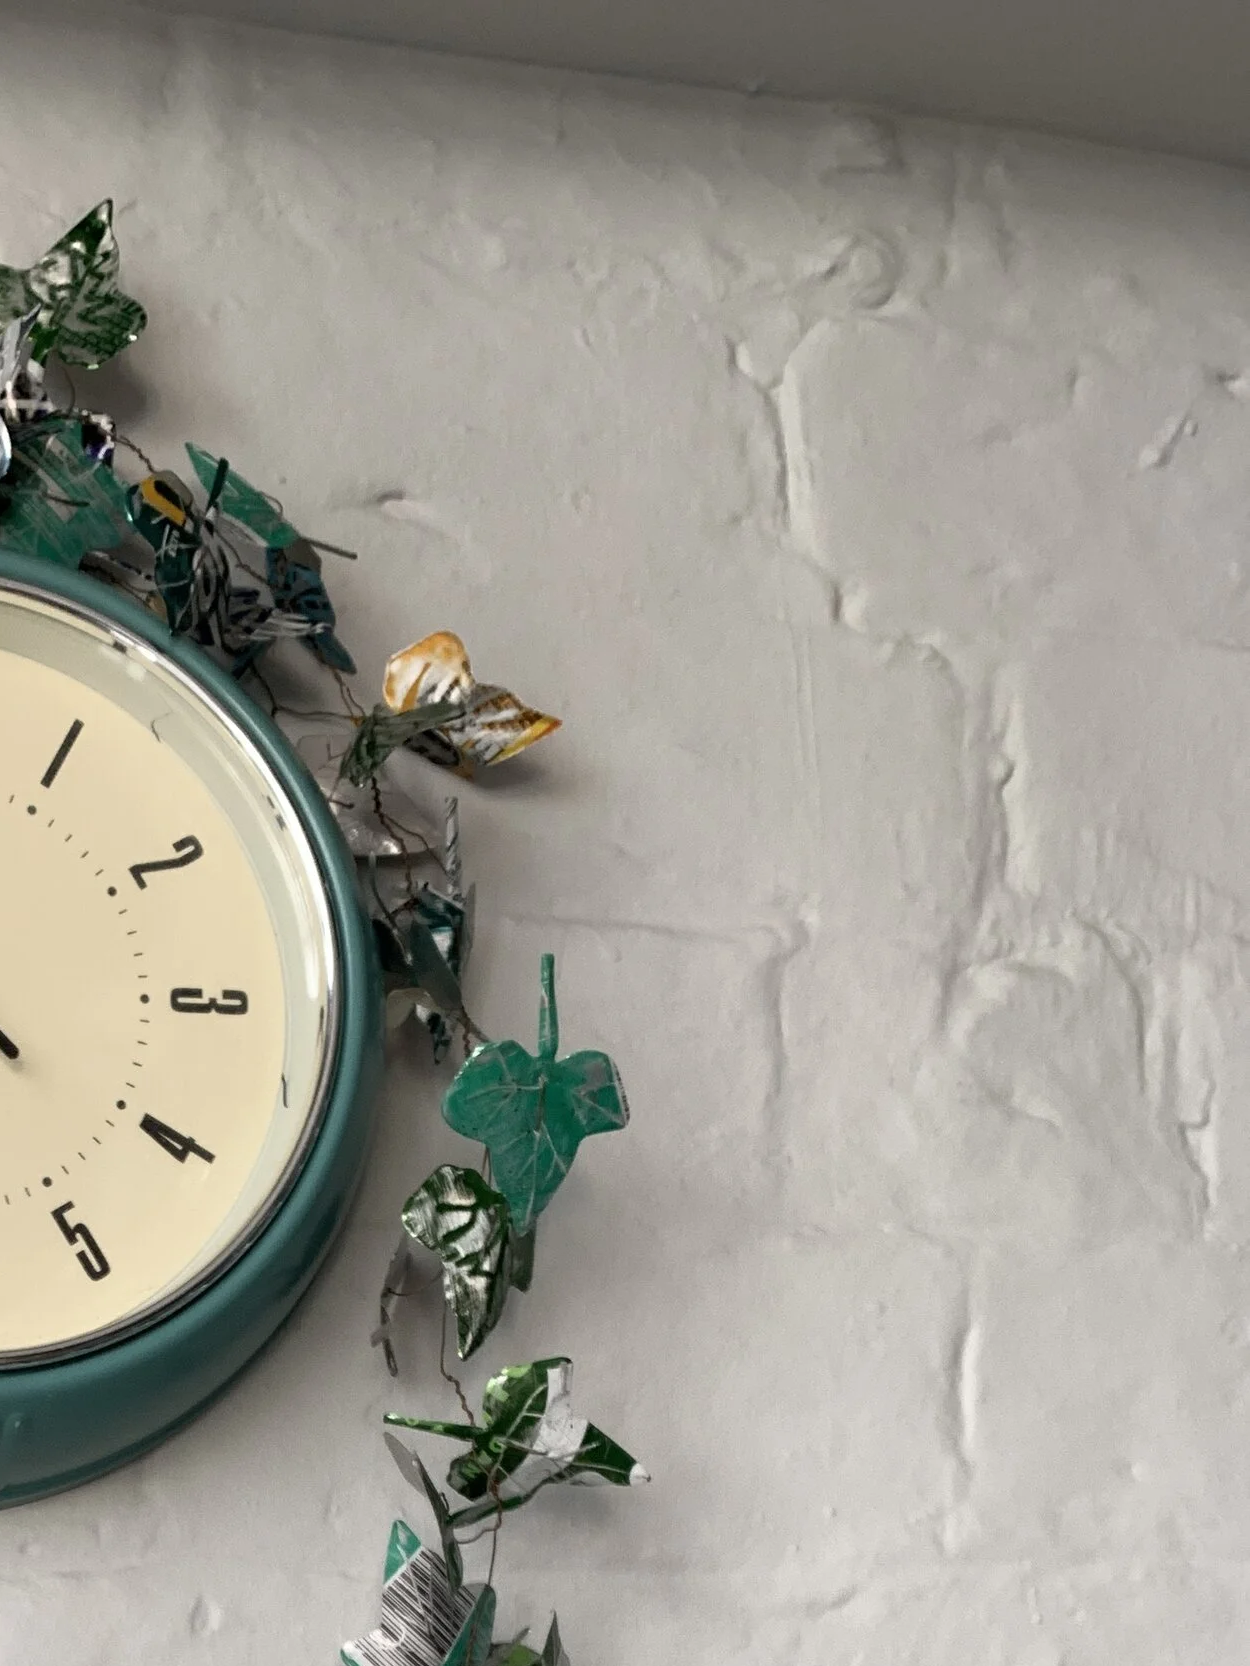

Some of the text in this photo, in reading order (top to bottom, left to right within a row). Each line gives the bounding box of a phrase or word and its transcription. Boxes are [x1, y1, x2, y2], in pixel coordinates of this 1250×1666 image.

[40, 719, 85, 788] 1
[128, 835, 204, 891] 2
[170, 986, 249, 1016] 3
[139, 1112, 216, 1164] 4
[50, 1200, 111, 1283] 5
